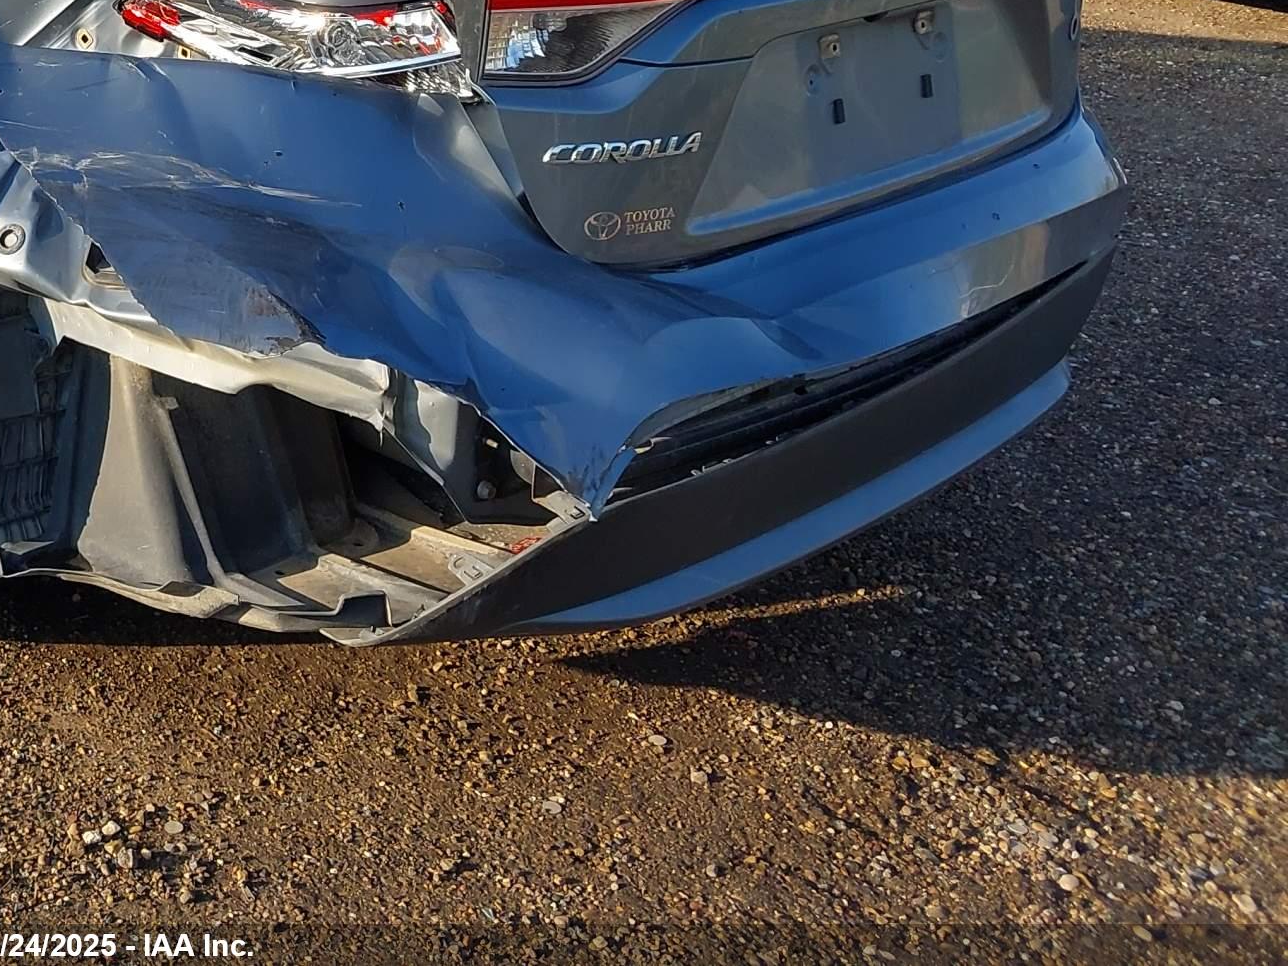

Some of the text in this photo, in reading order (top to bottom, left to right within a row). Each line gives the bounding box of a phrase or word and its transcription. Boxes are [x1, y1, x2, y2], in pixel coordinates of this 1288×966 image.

[542, 131, 703, 164] COROLLA
[624, 206, 676, 223] TOYOTA
[625, 219, 672, 236] PHARR
